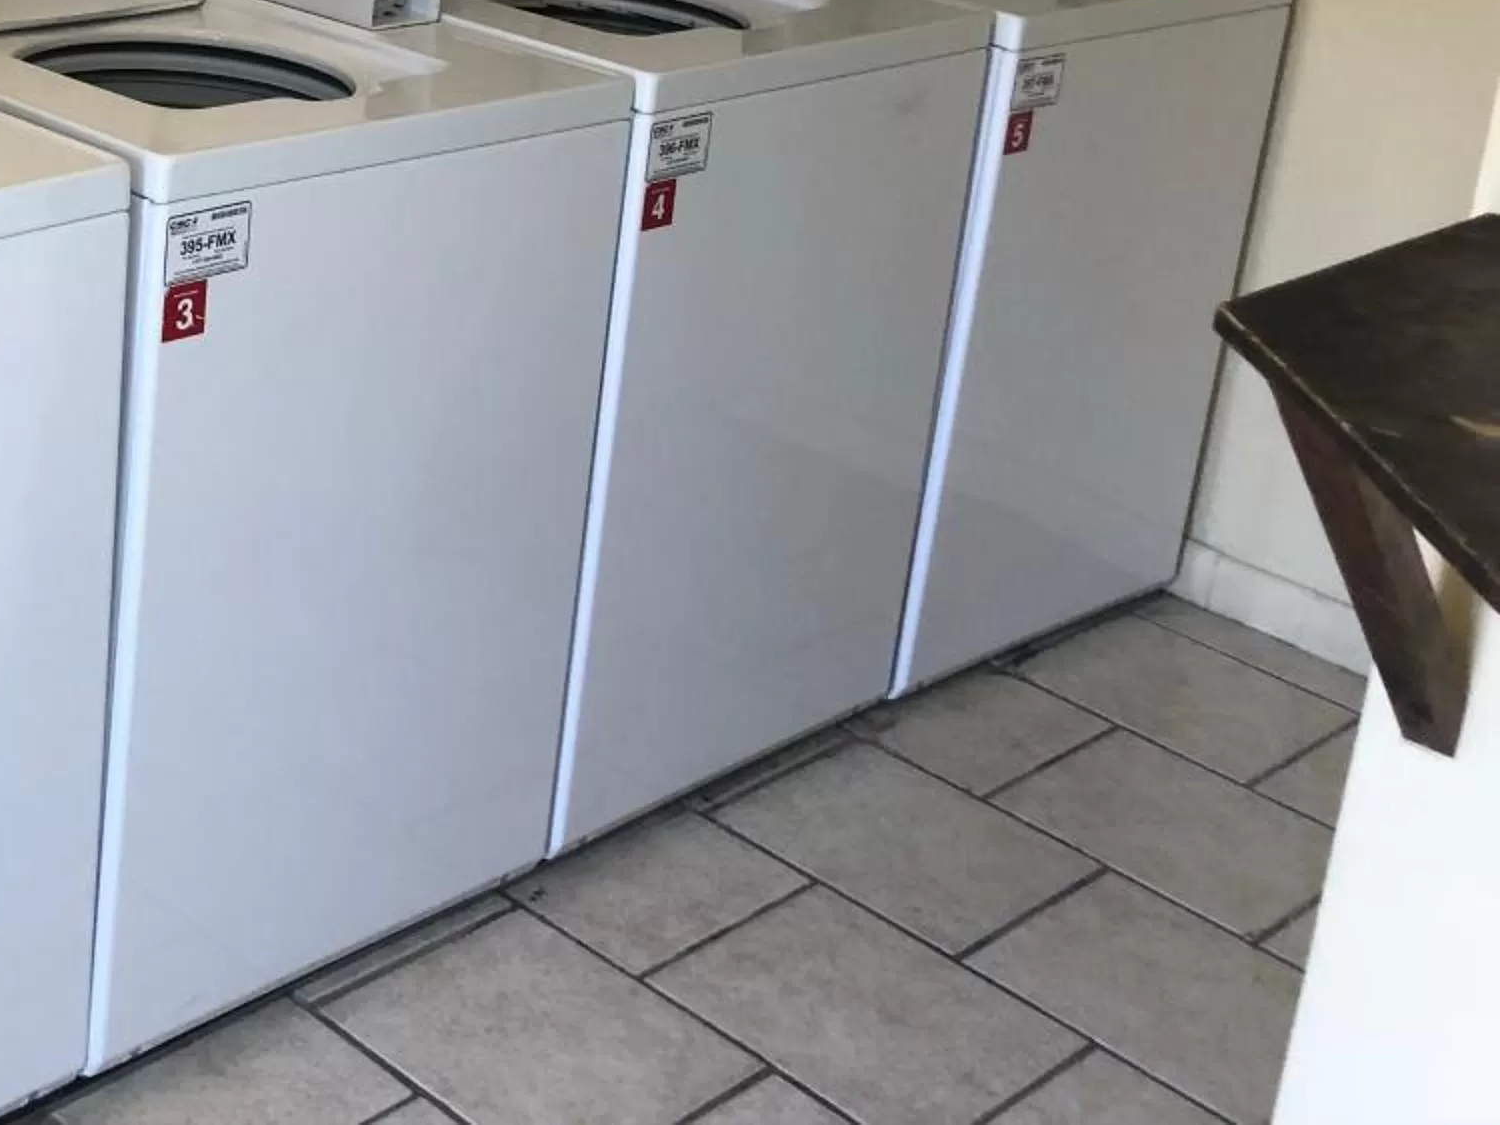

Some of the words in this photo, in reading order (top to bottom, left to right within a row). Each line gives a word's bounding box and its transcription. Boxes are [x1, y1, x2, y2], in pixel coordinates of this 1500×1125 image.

[1012, 123, 1026, 148] 5
[652, 194, 667, 221] 4
[180, 230, 238, 256] 395-FMX
[175, 298, 195, 331] 3
